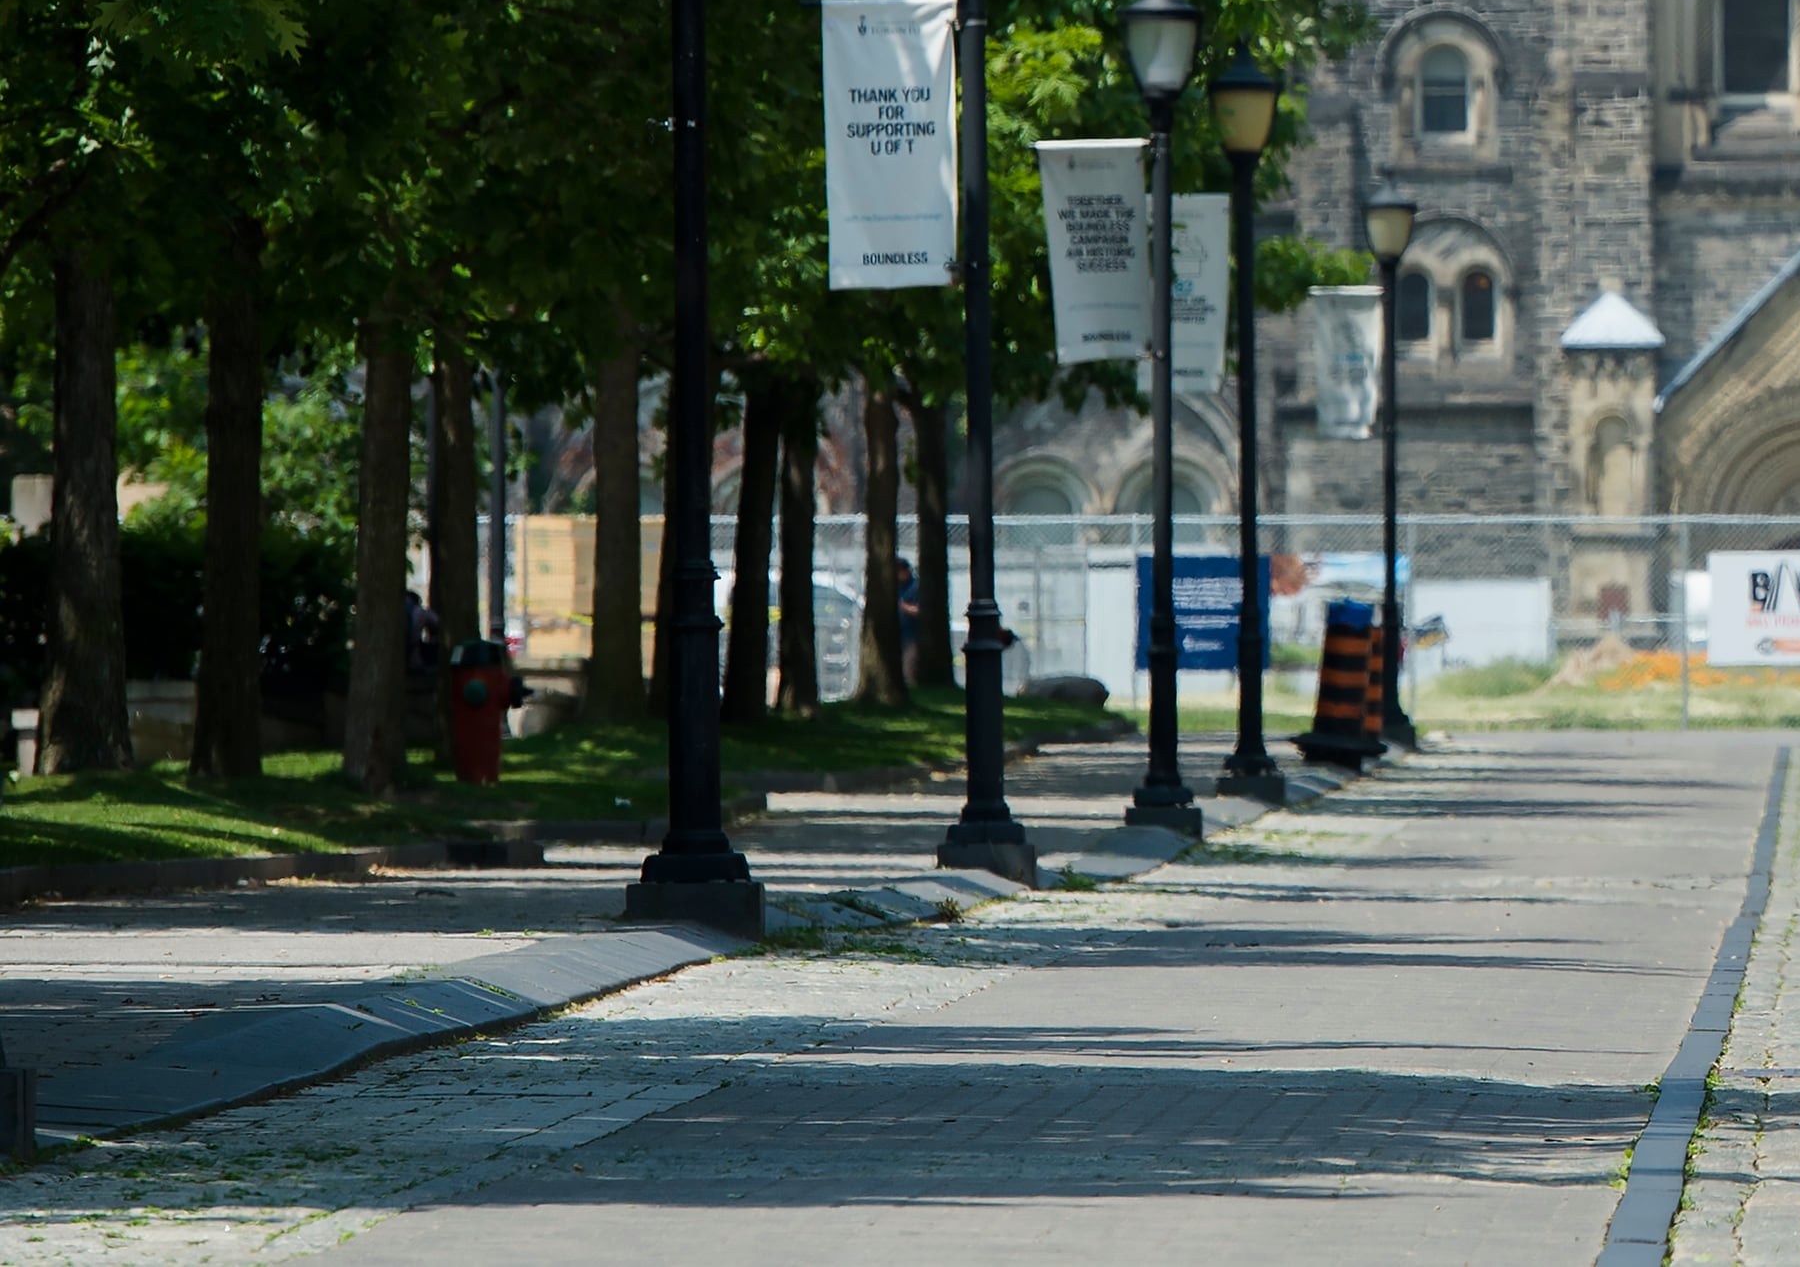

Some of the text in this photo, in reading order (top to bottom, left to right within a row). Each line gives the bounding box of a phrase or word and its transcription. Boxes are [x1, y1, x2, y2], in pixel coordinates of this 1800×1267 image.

[849, 87, 930, 103] THANK YOU
[878, 105, 904, 120] FOR
[847, 121, 935, 138] SUPPORTING
[871, 139, 914, 155] U OF T
[1057, 208, 1076, 220] WE
[862, 252, 928, 265] BOUNDLESS
